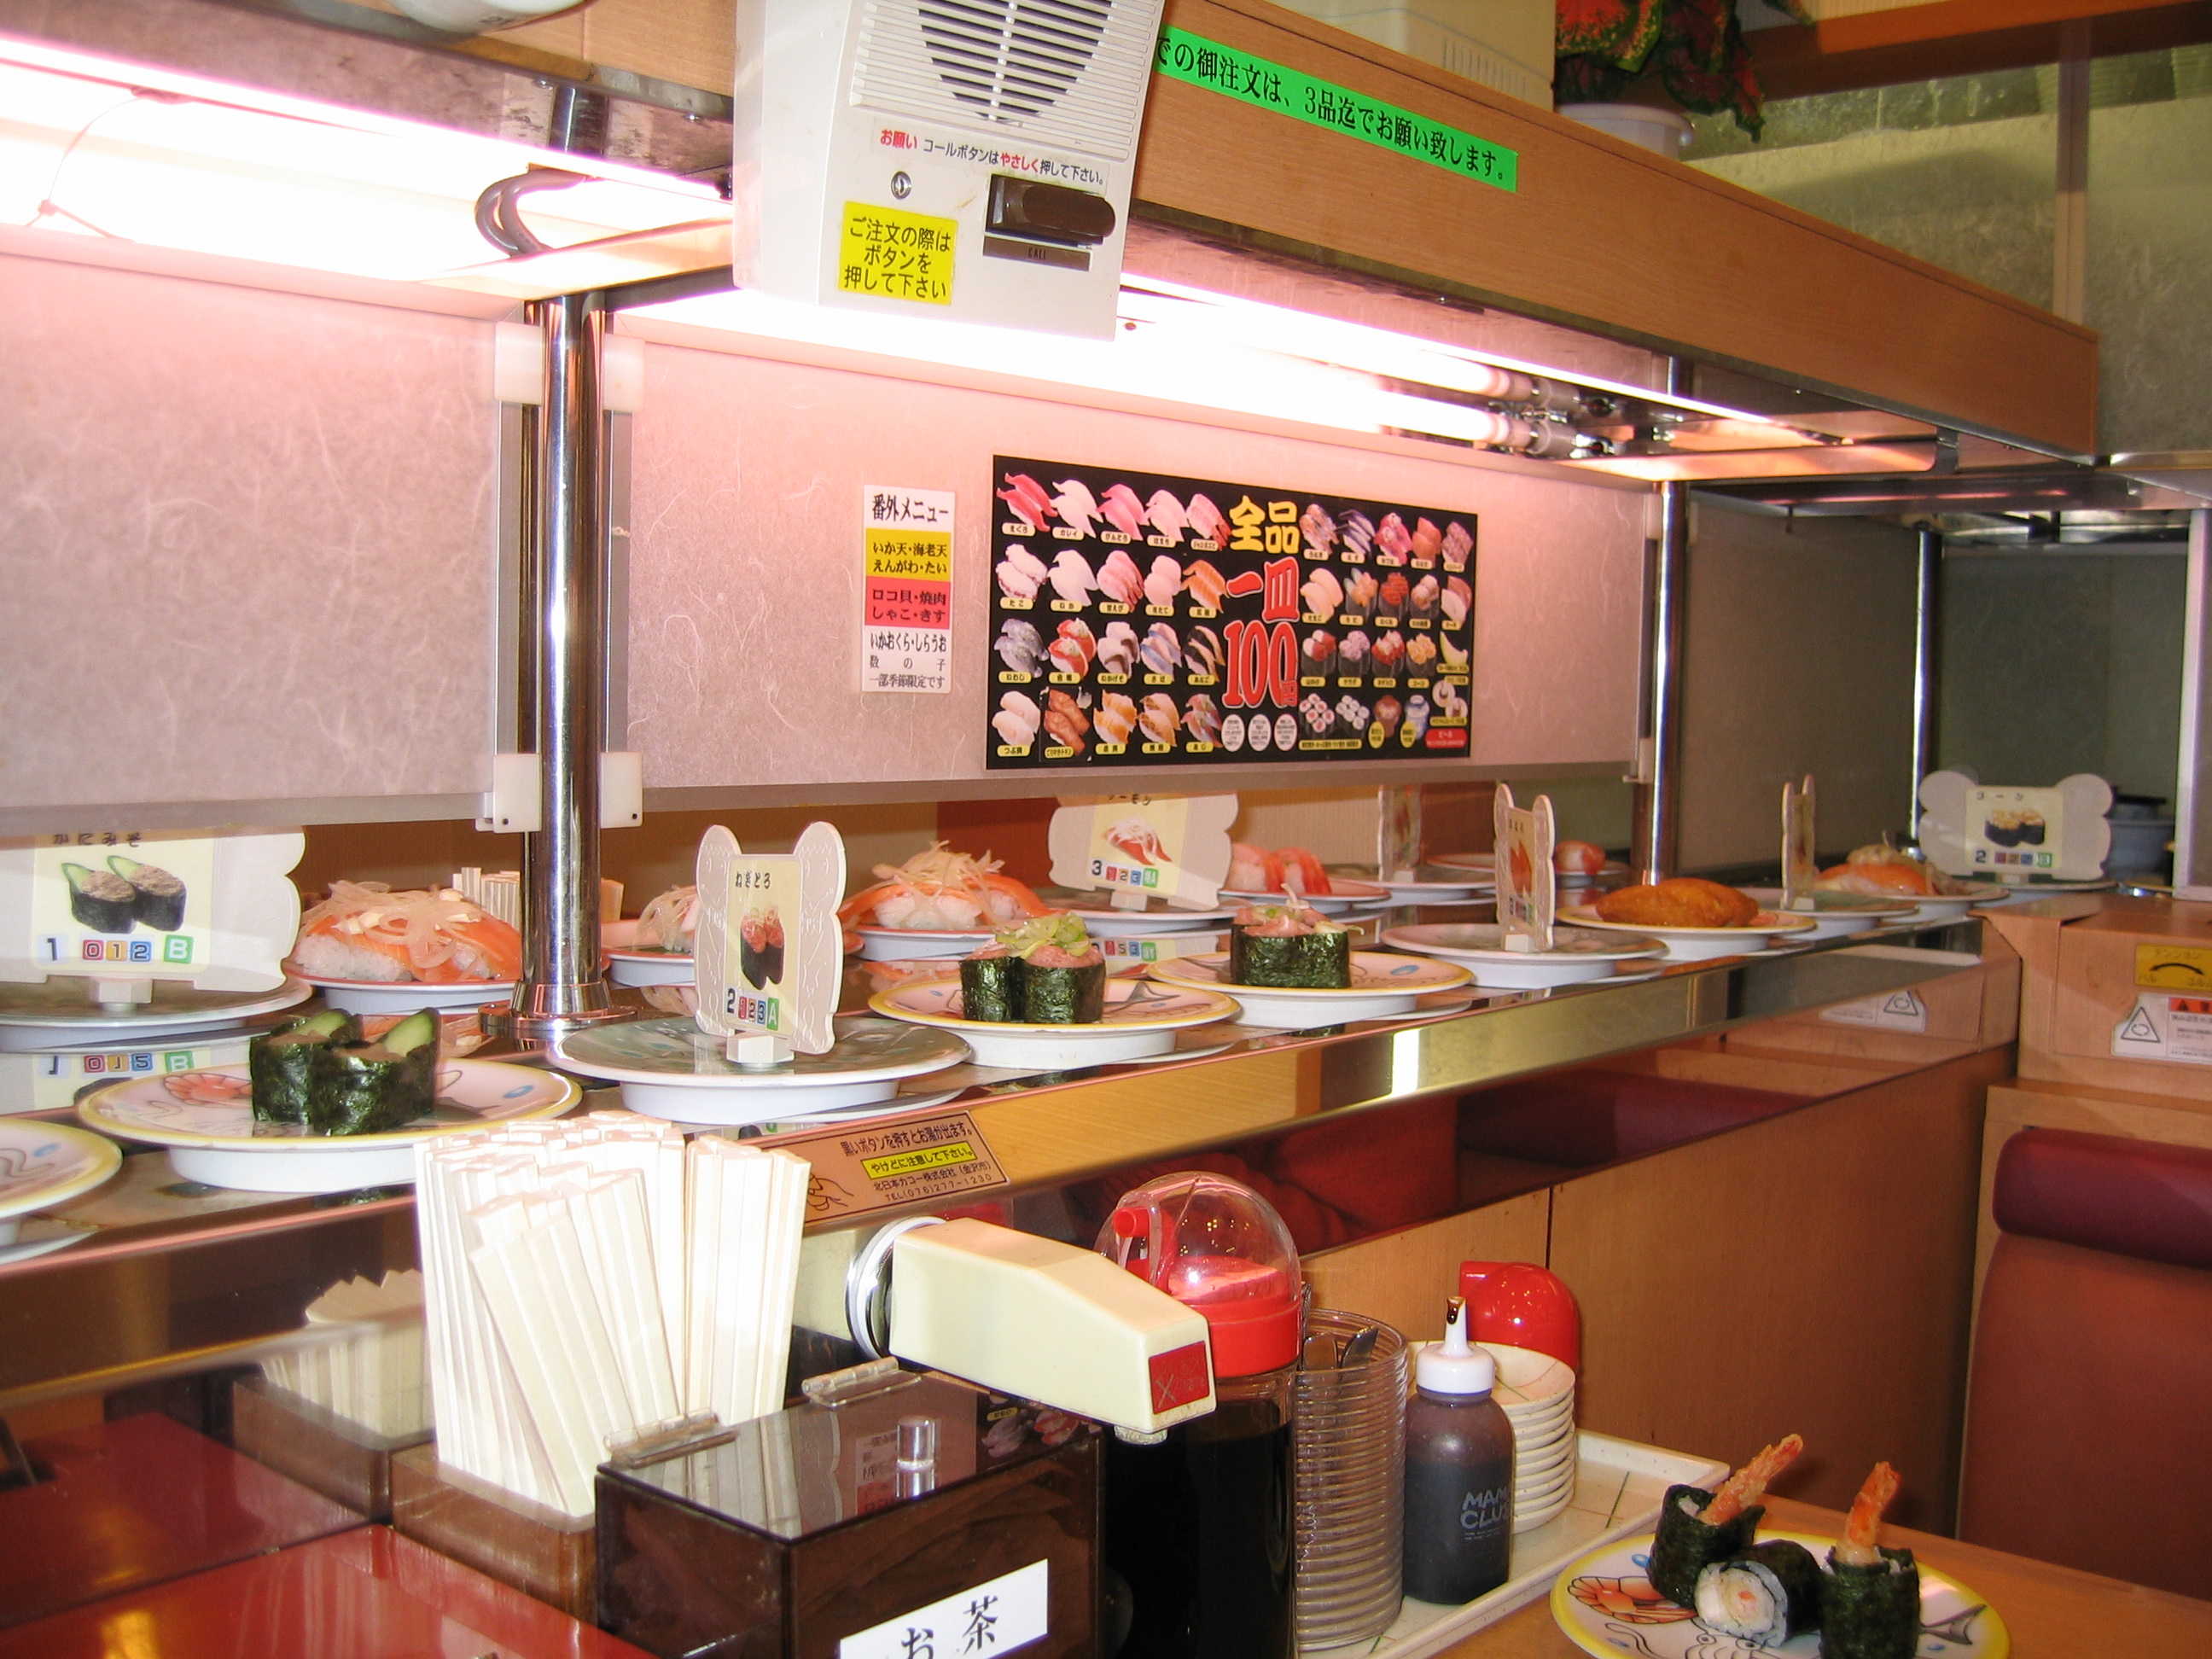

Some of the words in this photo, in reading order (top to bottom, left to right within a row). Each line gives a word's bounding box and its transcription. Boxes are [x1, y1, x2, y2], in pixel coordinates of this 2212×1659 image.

[880, 129, 918, 150] お願い
[849, 216, 952, 253] ご注文の際は
[864, 245, 933, 274] ボタンを
[1027, 246, 1047, 260] CALL
[843, 265, 947, 300] 押して下さい
[871, 492, 950, 523] 番外メニュー
[1229, 495, 1301, 554] 全品
[1226, 556, 1300, 623] 一皿
[1091, 859, 1103, 876] 3
[47, 938, 57, 961] 1
[168, 938, 189, 959] B
[726, 987, 736, 1014] 2
[768, 1002, 777, 1026] A
[901, 1595, 998, 1659] お茶
